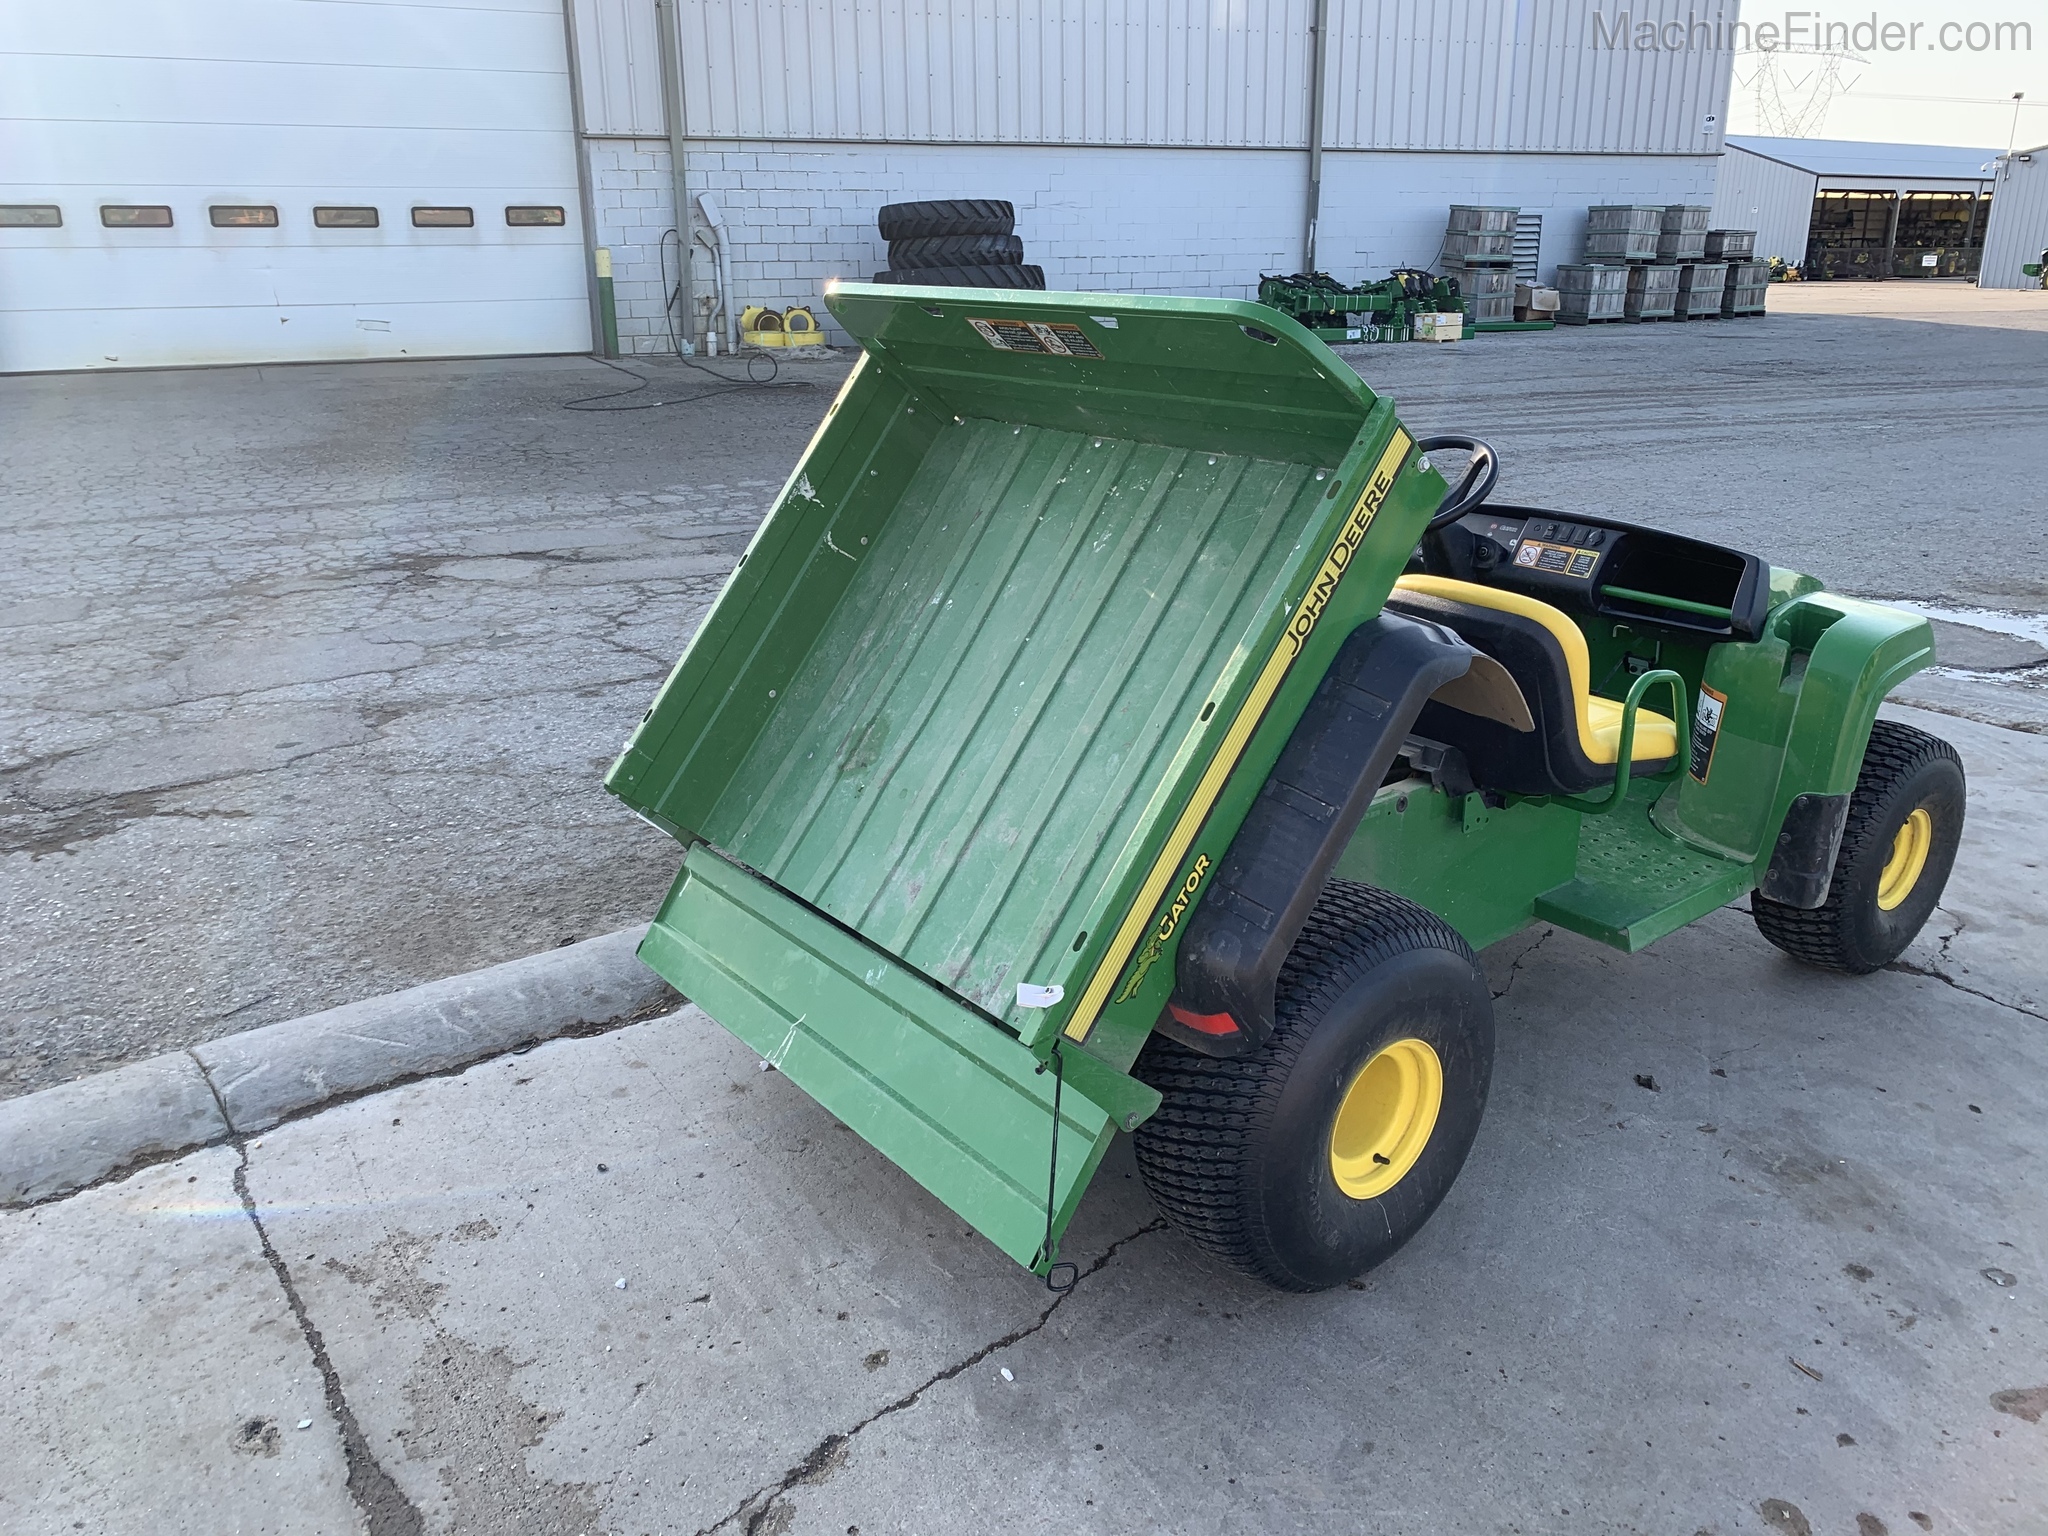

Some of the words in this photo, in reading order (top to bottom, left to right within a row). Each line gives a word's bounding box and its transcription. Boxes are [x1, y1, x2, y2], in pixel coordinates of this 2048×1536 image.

[1287, 572, 1336, 656] JOHN
[1330, 471, 1391, 571] DEERE
[1158, 853, 1210, 941] GATOR
